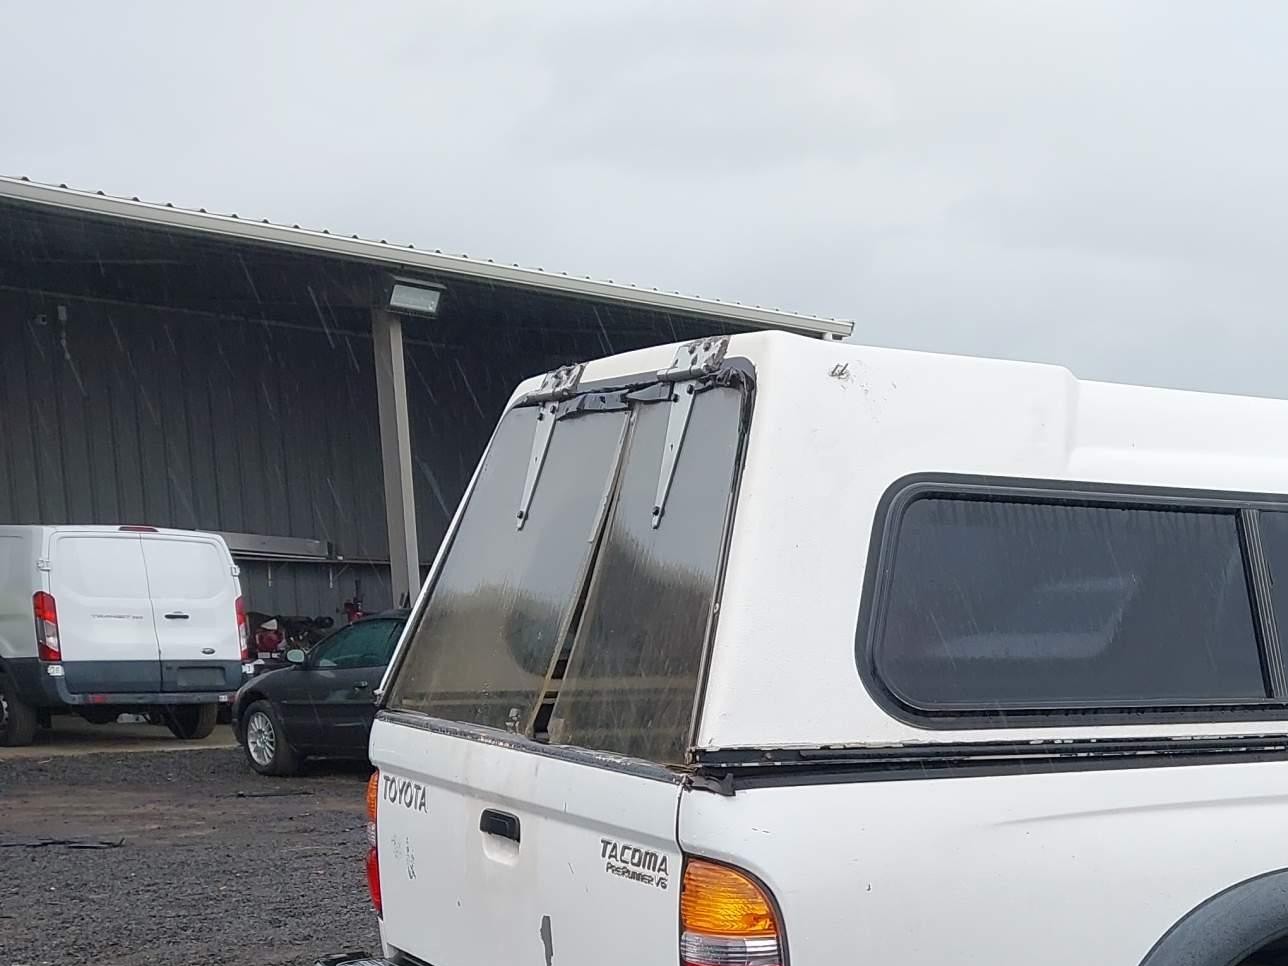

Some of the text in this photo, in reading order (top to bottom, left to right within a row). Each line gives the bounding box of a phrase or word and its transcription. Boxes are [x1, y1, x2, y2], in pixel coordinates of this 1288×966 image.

[383, 774, 428, 814] TOYOTA
[600, 839, 669, 876] TACOMA
[655, 876, 668, 890] V6
